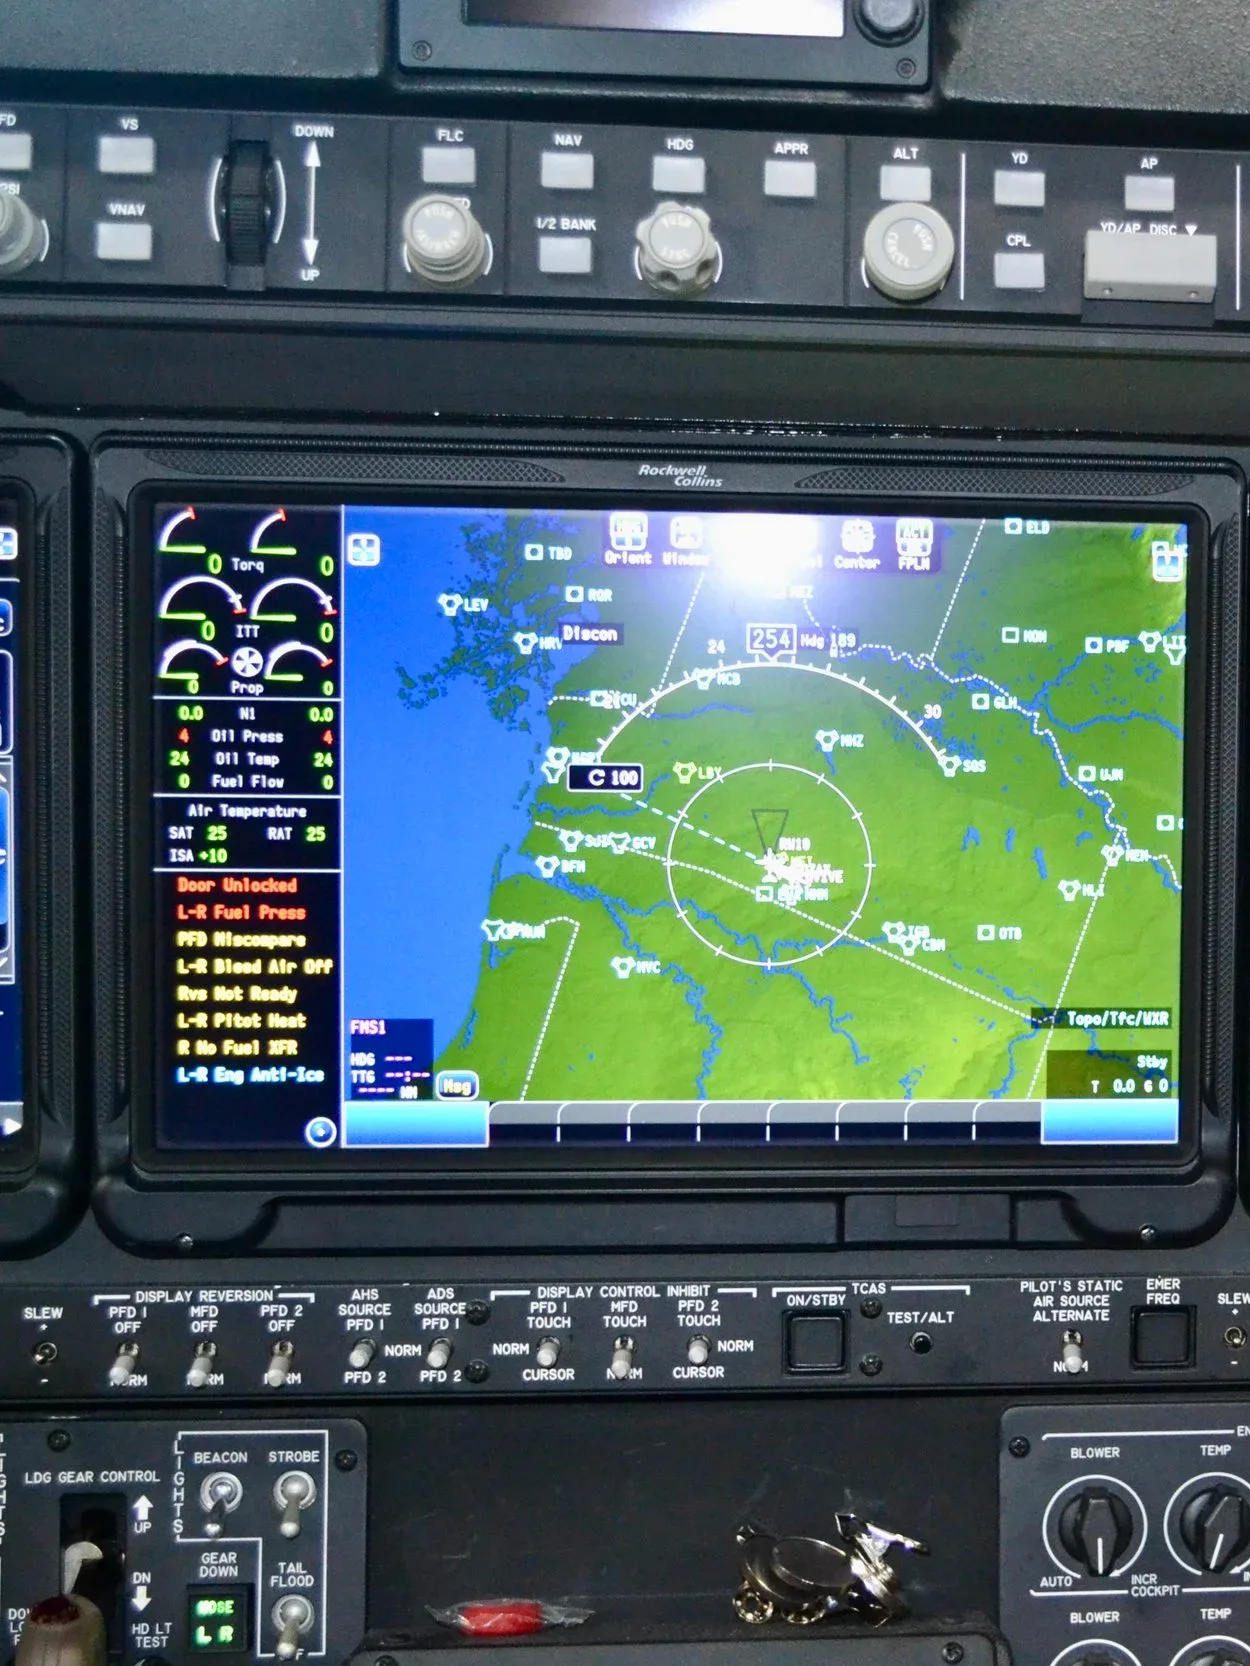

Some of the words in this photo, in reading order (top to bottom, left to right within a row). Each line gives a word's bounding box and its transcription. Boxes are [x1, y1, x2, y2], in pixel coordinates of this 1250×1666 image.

[120, 118, 139, 130] VS
[295, 125, 334, 138] DOWN
[437, 129, 465, 143] FLC
[554, 134, 582, 147] NAV
[667, 138, 694, 151] HDG
[774, 143, 809, 155] APPR
[893, 148, 919, 160] ALT
[1011, 152, 1028, 164] YD
[1140, 158, 1158, 169] AP
[108, 203, 145, 216] VNAV
[537, 218, 556, 230] 1/2
[561, 218, 597, 232] BANK
[301, 269, 320, 281] UP
[639, 465, 706, 476] Rockwell
[674, 476, 723, 487] Collins
[232, 558, 264, 574] Torq
[236, 625, 260, 638] ITT
[752, 629, 791, 648] 254
[231, 681, 264, 696] Prop
[212, 729, 234, 742] Oil
[243, 730, 284, 743] Press
[169, 751, 189, 766] 24
[216, 752, 238, 765] Oil
[247, 752, 279, 768] Temp
[314, 753, 333, 767] 24
[212, 774, 243, 788] Fuel
[251, 775, 284, 788] Flow
[611, 771, 638, 785] 100
[188, 804, 213, 817] Air
[220, 804, 306, 819] Temperature
[168, 826, 194, 839] SAT
[207, 825, 227, 840] 25
[267, 827, 292, 840] RAT
[305, 826, 326, 841] 25
[170, 849, 194, 862] ISA
[199, 848, 227, 863] +10
[178, 877, 215, 892] Door
[223, 878, 297, 893] Unlocked
[178, 904, 207, 919] L-R
[214, 904, 250, 920] Fuel
[260, 905, 306, 920] Press
[350, 1021, 386, 1035] FMS1
[178, 1067, 207, 1082] L-R
[214, 1067, 244, 1084] Eng
[250, 1067, 324, 1082] Anti-Ice
[351, 1071, 375, 1082] TTG
[852, 1283, 886, 1295] TCAS
[1020, 1281, 1072, 1293] PILOT'S
[1078, 1281, 1123, 1292] STATIC
[1146, 1278, 1180, 1291] EMER
[135, 1291, 193, 1303] DISPLAY
[199, 1291, 274, 1303] REVERSION
[351, 1289, 379, 1300] AHS
[427, 1288, 454, 1299] ADS
[537, 1286, 593, 1299] DISPLAY
[600, 1286, 660, 1298] CONTROL
[667, 1285, 710, 1296] INHIBIT
[786, 1294, 846, 1306] ON/STBY
[1033, 1295, 1056, 1307] AIR
[1060, 1295, 1110, 1306] SOURCE
[1146, 1293, 1180, 1305] FREQ
[24, 1308, 63, 1319] SLEW
[190, 1306, 219, 1318] MFD
[338, 1304, 391, 1316] SOURCE
[414, 1303, 466, 1315] SOURCE
[887, 1312, 954, 1324] TEST/ALT
[1033, 1310, 1110, 1322] ALTERNATE
[115, 1321, 141, 1334] OFF
[527, 1317, 571, 1329] TOUCH
[522, 1368, 575, 1381] CURSOR
[269, 1451, 320, 1462] STROBE
[1070, 1447, 1120, 1458] BLOWER
[1200, 1445, 1232, 1456] TEMP
[194, 1452, 247, 1464] BEACON
[25, 1472, 52, 1484] LDG
[59, 1471, 94, 1483] GEAR
[100, 1471, 160, 1483] CONTROL
[134, 1522, 152, 1533] UP
[202, 1553, 237, 1565] GEAR
[199, 1565, 238, 1577] DOWN
[279, 1562, 307, 1574] TAIL
[271, 1575, 314, 1587] FLOOD
[1131, 1585, 1180, 1597] COCKPIT
[196, 1601, 235, 1615] NOSE
[135, 1636, 168, 1648] TEST
